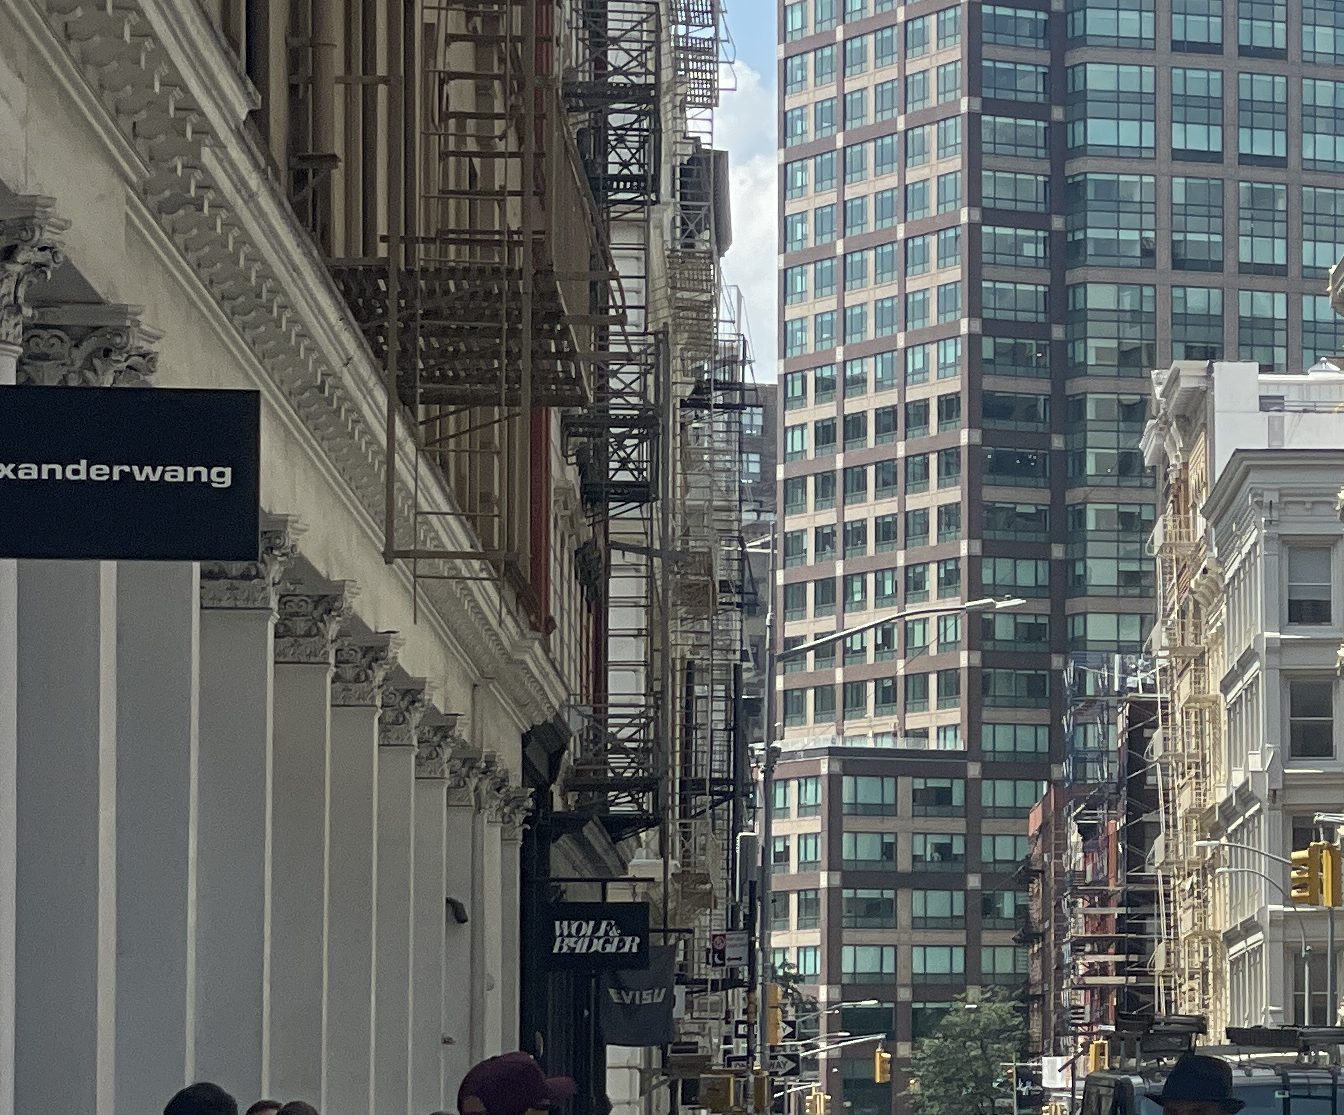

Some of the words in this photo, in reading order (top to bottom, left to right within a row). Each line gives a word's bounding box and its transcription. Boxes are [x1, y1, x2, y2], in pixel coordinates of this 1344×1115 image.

[0, 459, 233, 488] xanderwang
[552, 936, 641, 954] BADGER
[608, 987, 667, 1005] EVISU
